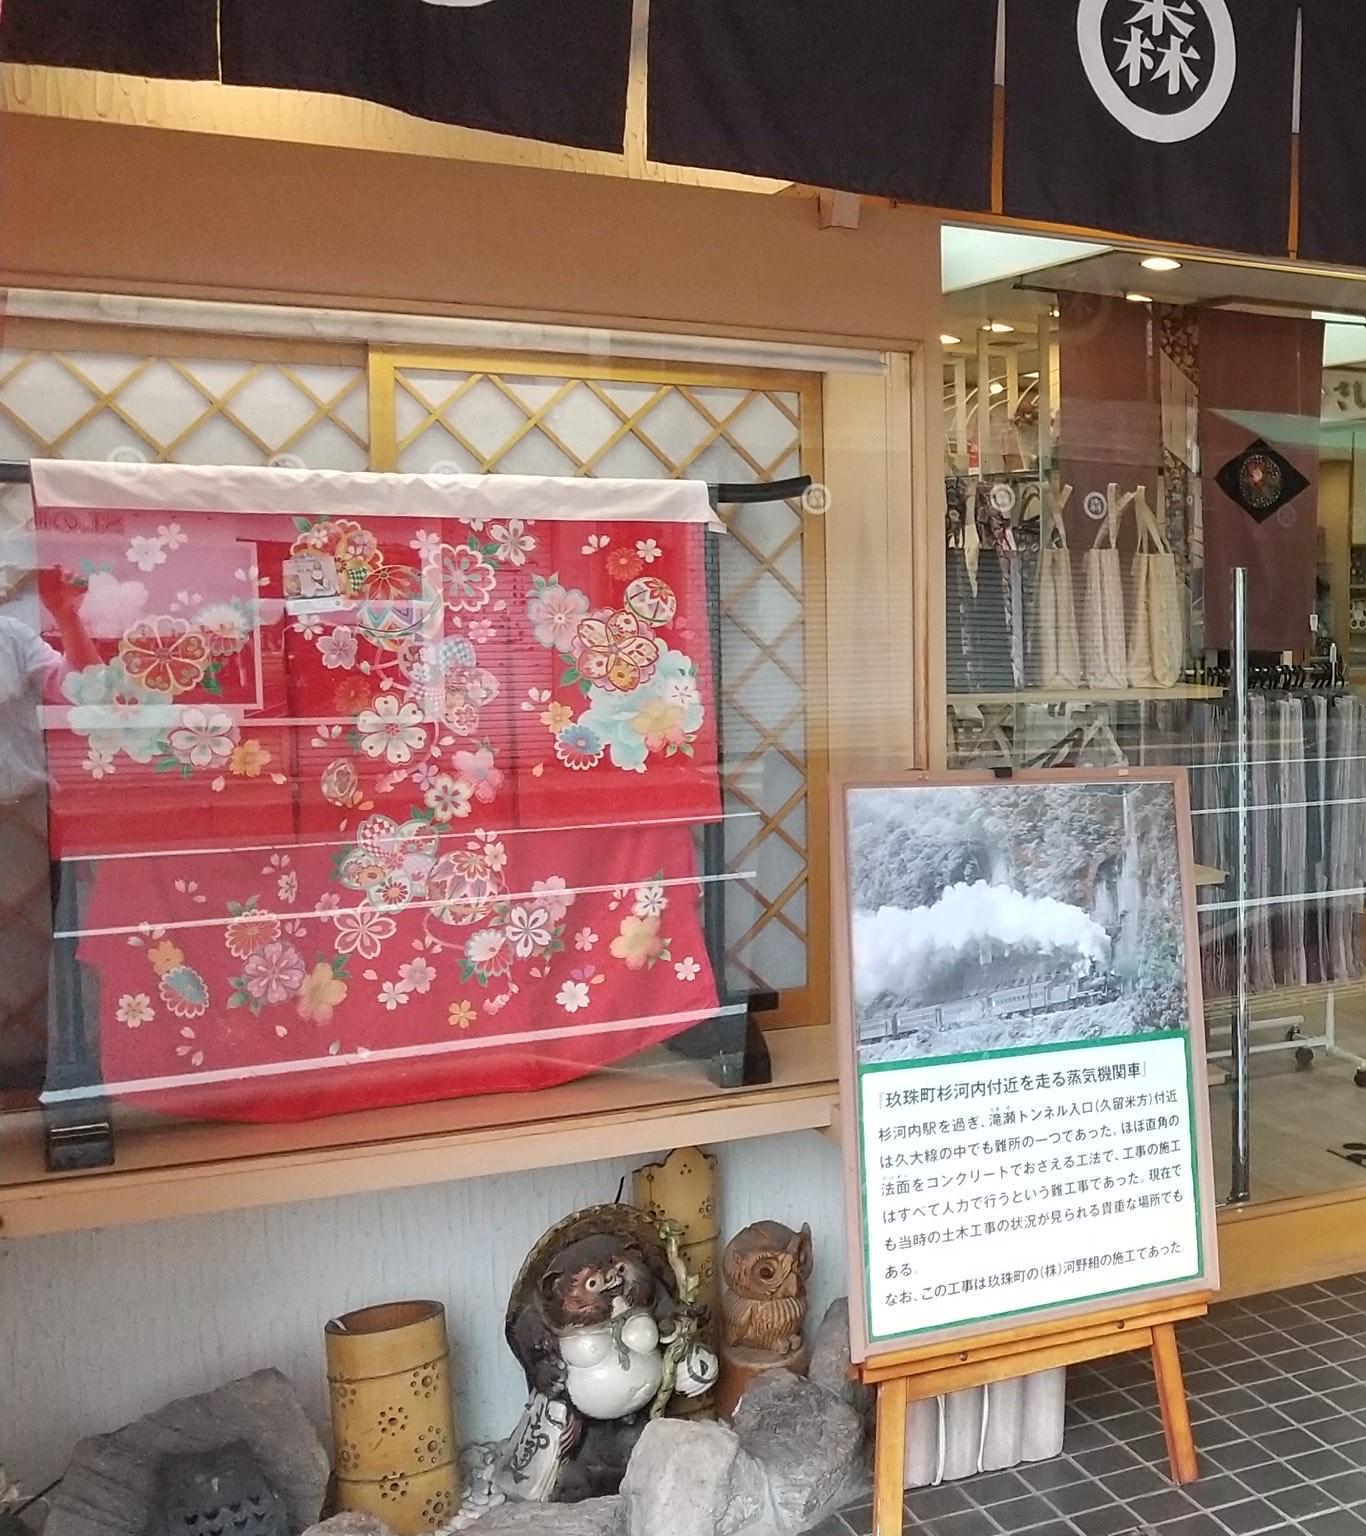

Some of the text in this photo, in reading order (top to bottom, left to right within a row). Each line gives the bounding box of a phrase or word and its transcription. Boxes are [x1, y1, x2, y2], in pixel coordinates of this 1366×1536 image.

[1113, 0, 1201, 95] 森
[881, 1139, 1182, 1197] 法面をコンクリートでおさえる工法で、工事の施工
[883, 1164, 1182, 1224] はすべて人力で行うという難工事であった。現在で
[884, 1189, 1184, 1252] も当時の土木工事の状況が見られる貴重な場所でも
